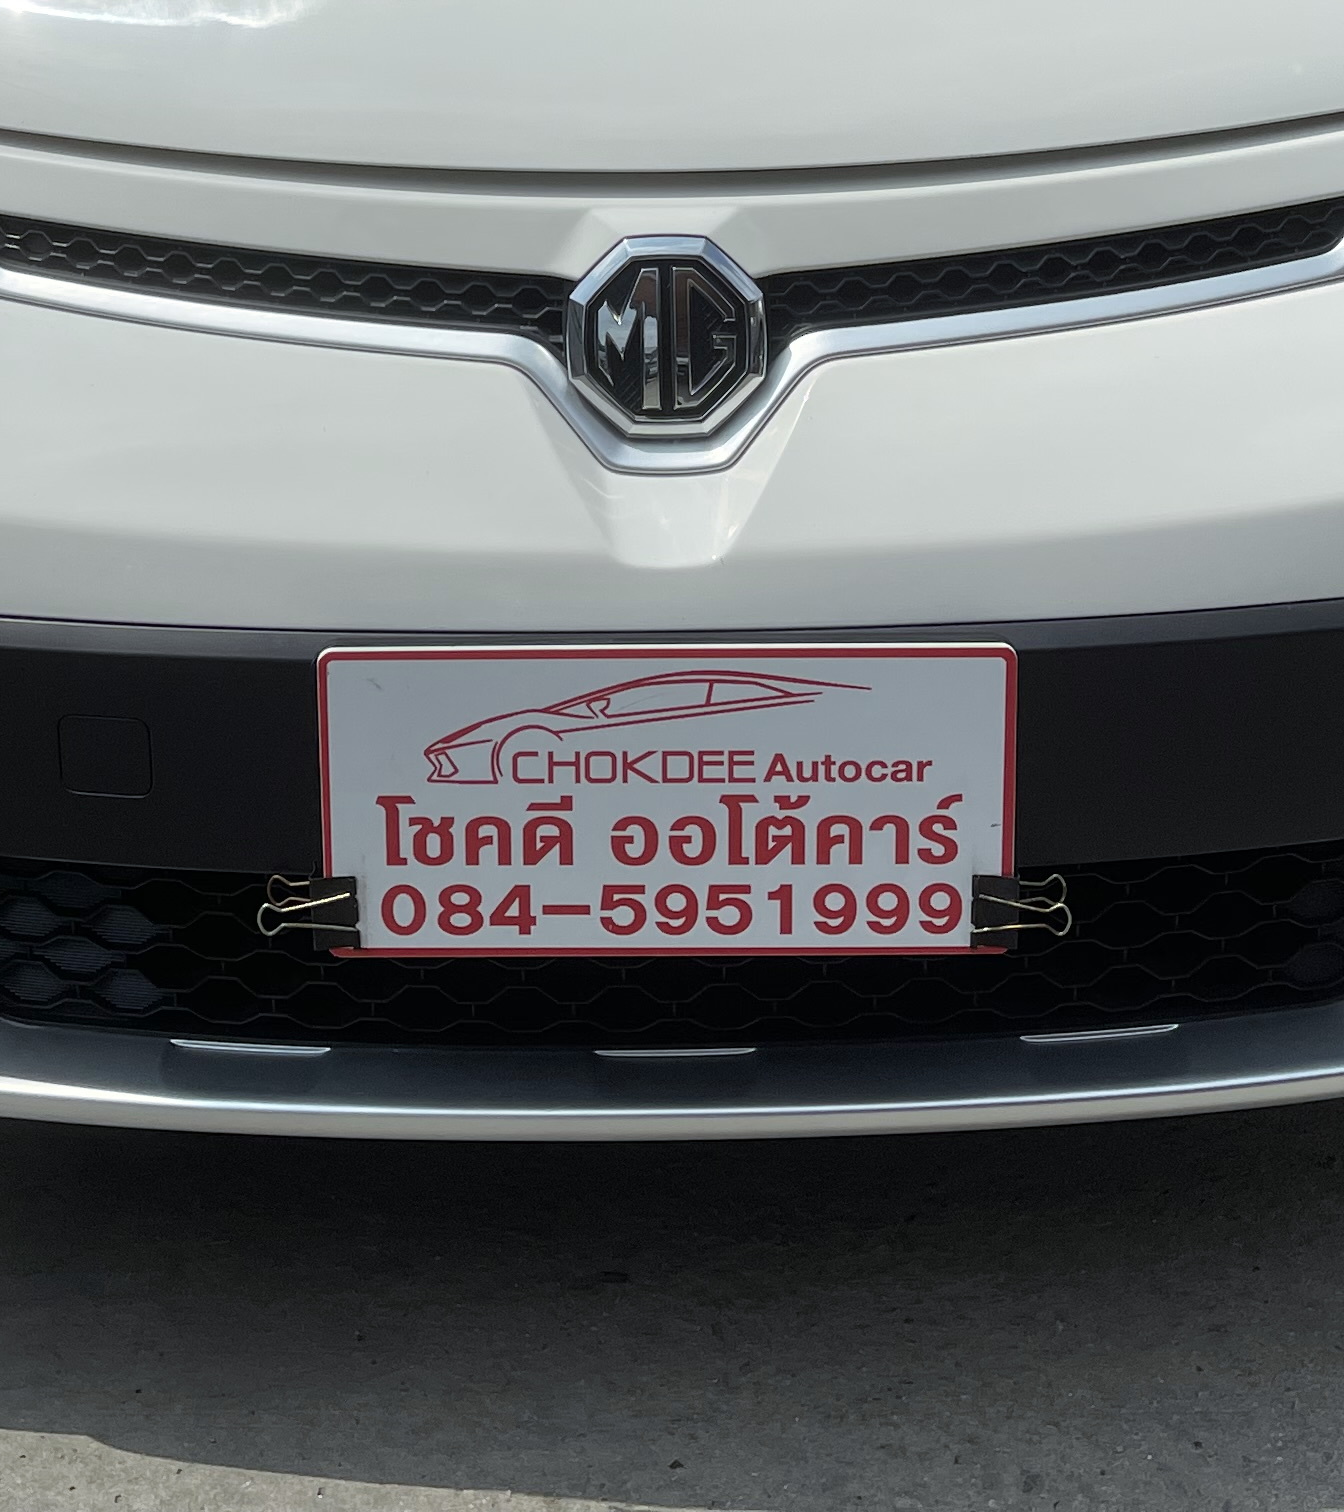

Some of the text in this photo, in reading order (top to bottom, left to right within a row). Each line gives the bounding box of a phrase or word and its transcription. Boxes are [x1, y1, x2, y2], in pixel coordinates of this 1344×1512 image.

[597, 266, 737, 411] MG
[512, 750, 932, 784] CHOKDEE Autocar
[375, 793, 963, 866] โชคดี ออโต้คาร์
[380, 883, 963, 936] 084-5951999
